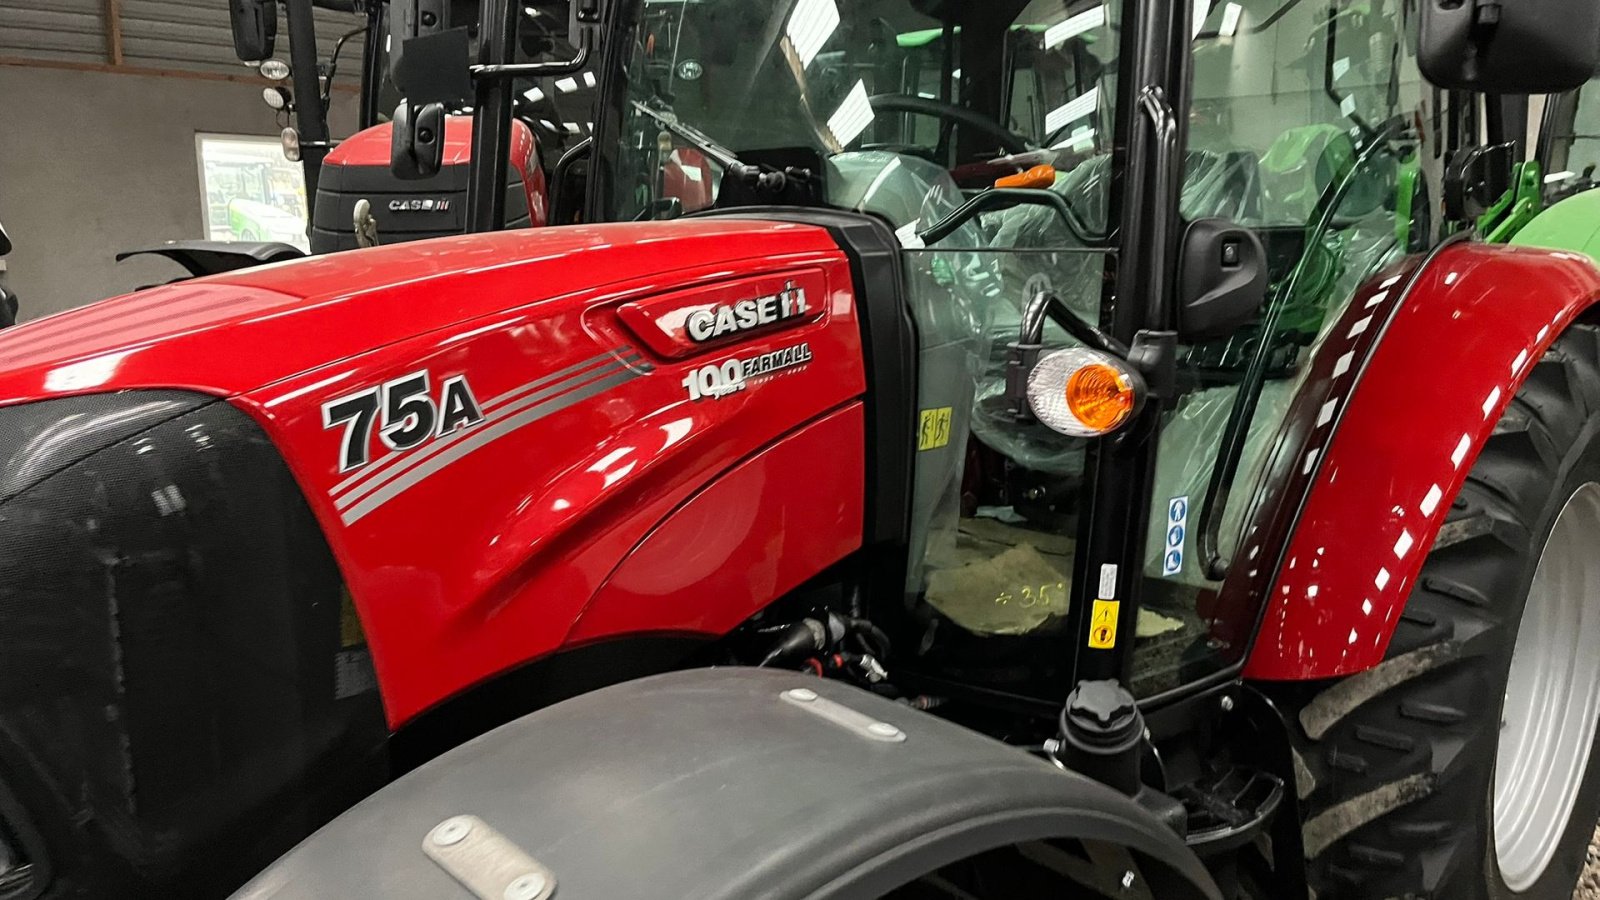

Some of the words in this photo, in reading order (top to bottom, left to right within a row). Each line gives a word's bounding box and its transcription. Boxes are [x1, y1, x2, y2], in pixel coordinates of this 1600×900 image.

[389, 200, 433, 211] CASE
[686, 296, 778, 342] CASE
[682, 358, 744, 401] 100
[741, 343, 812, 379] FARMALL
[320, 368, 487, 474] 75A
